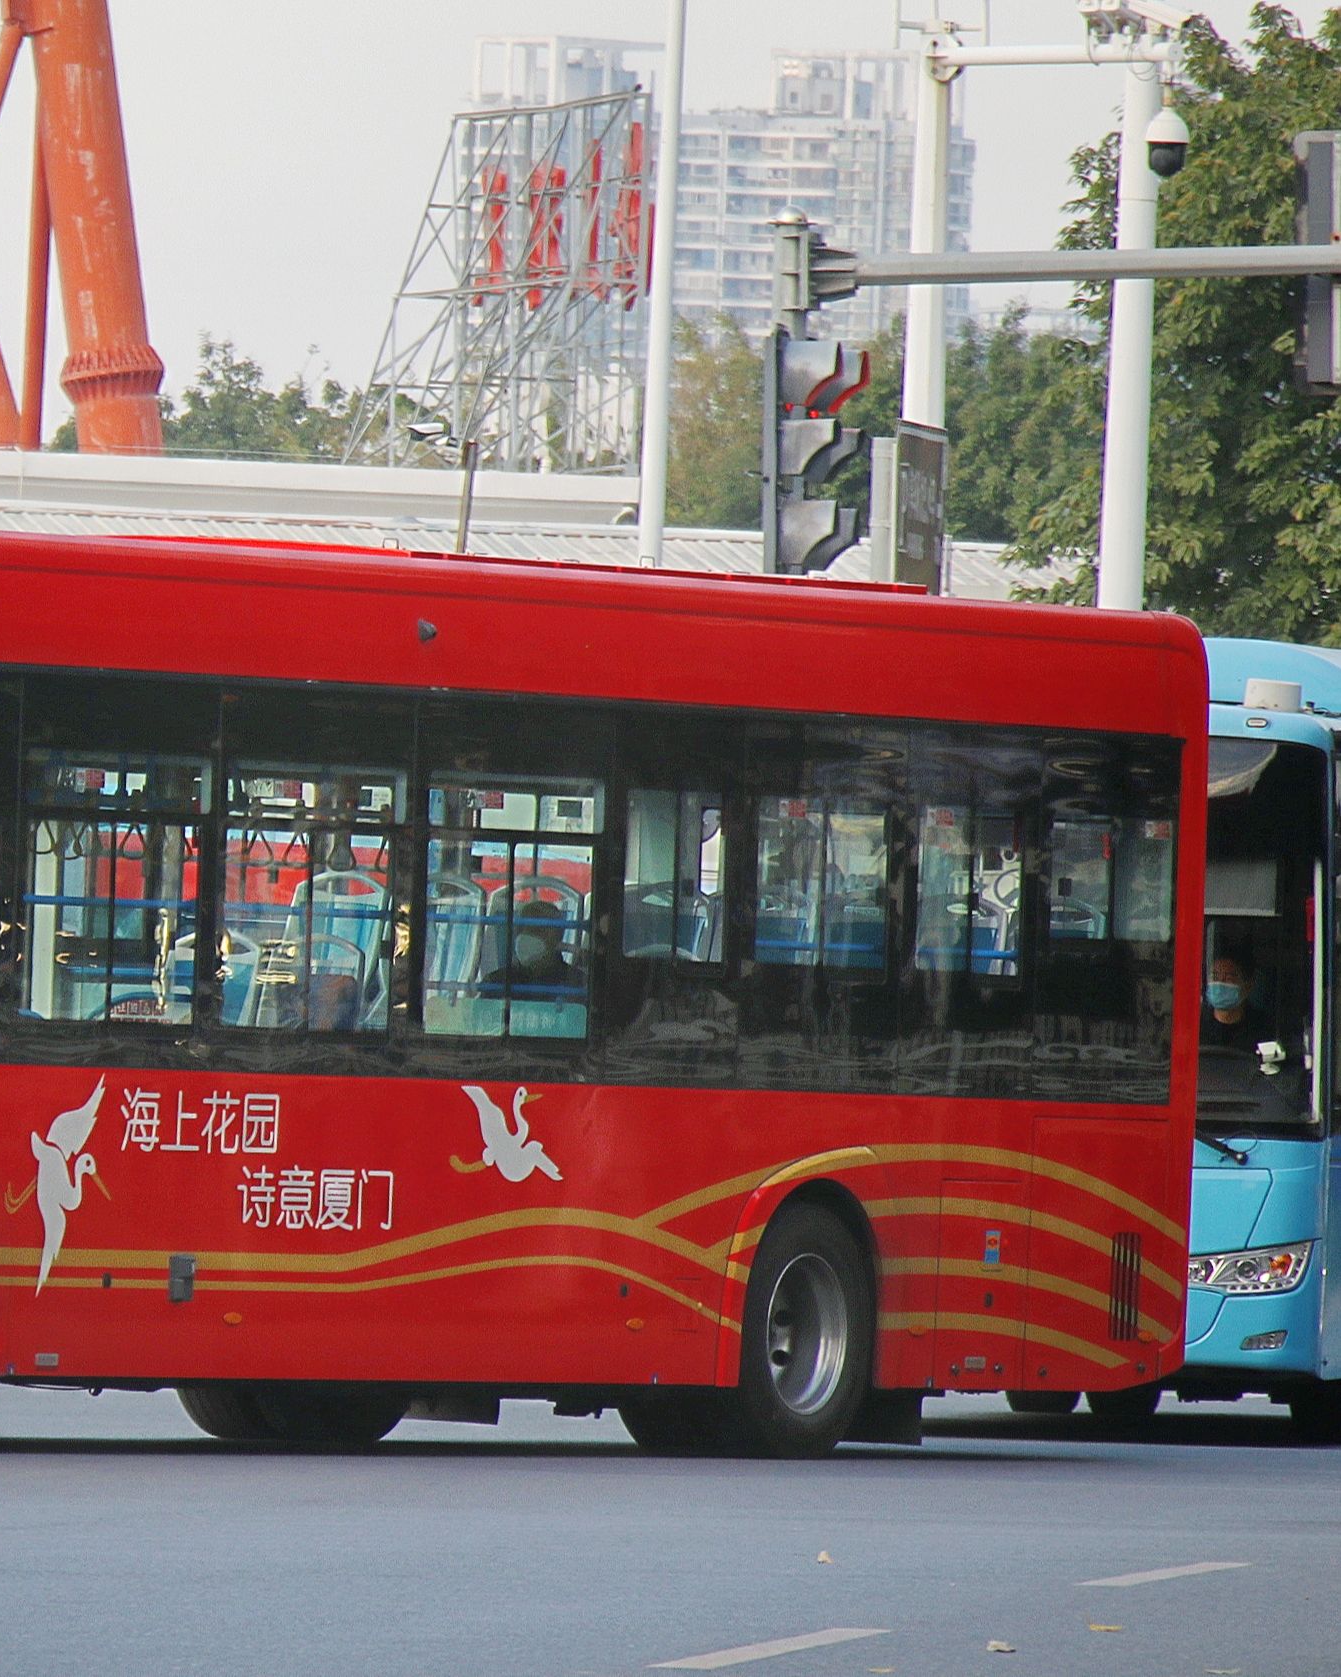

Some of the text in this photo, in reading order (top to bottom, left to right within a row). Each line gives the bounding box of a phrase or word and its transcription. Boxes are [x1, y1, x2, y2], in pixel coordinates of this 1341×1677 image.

[120, 1087, 280, 1155] 海上花园
[236, 1164, 394, 1231] 诗意厦门
